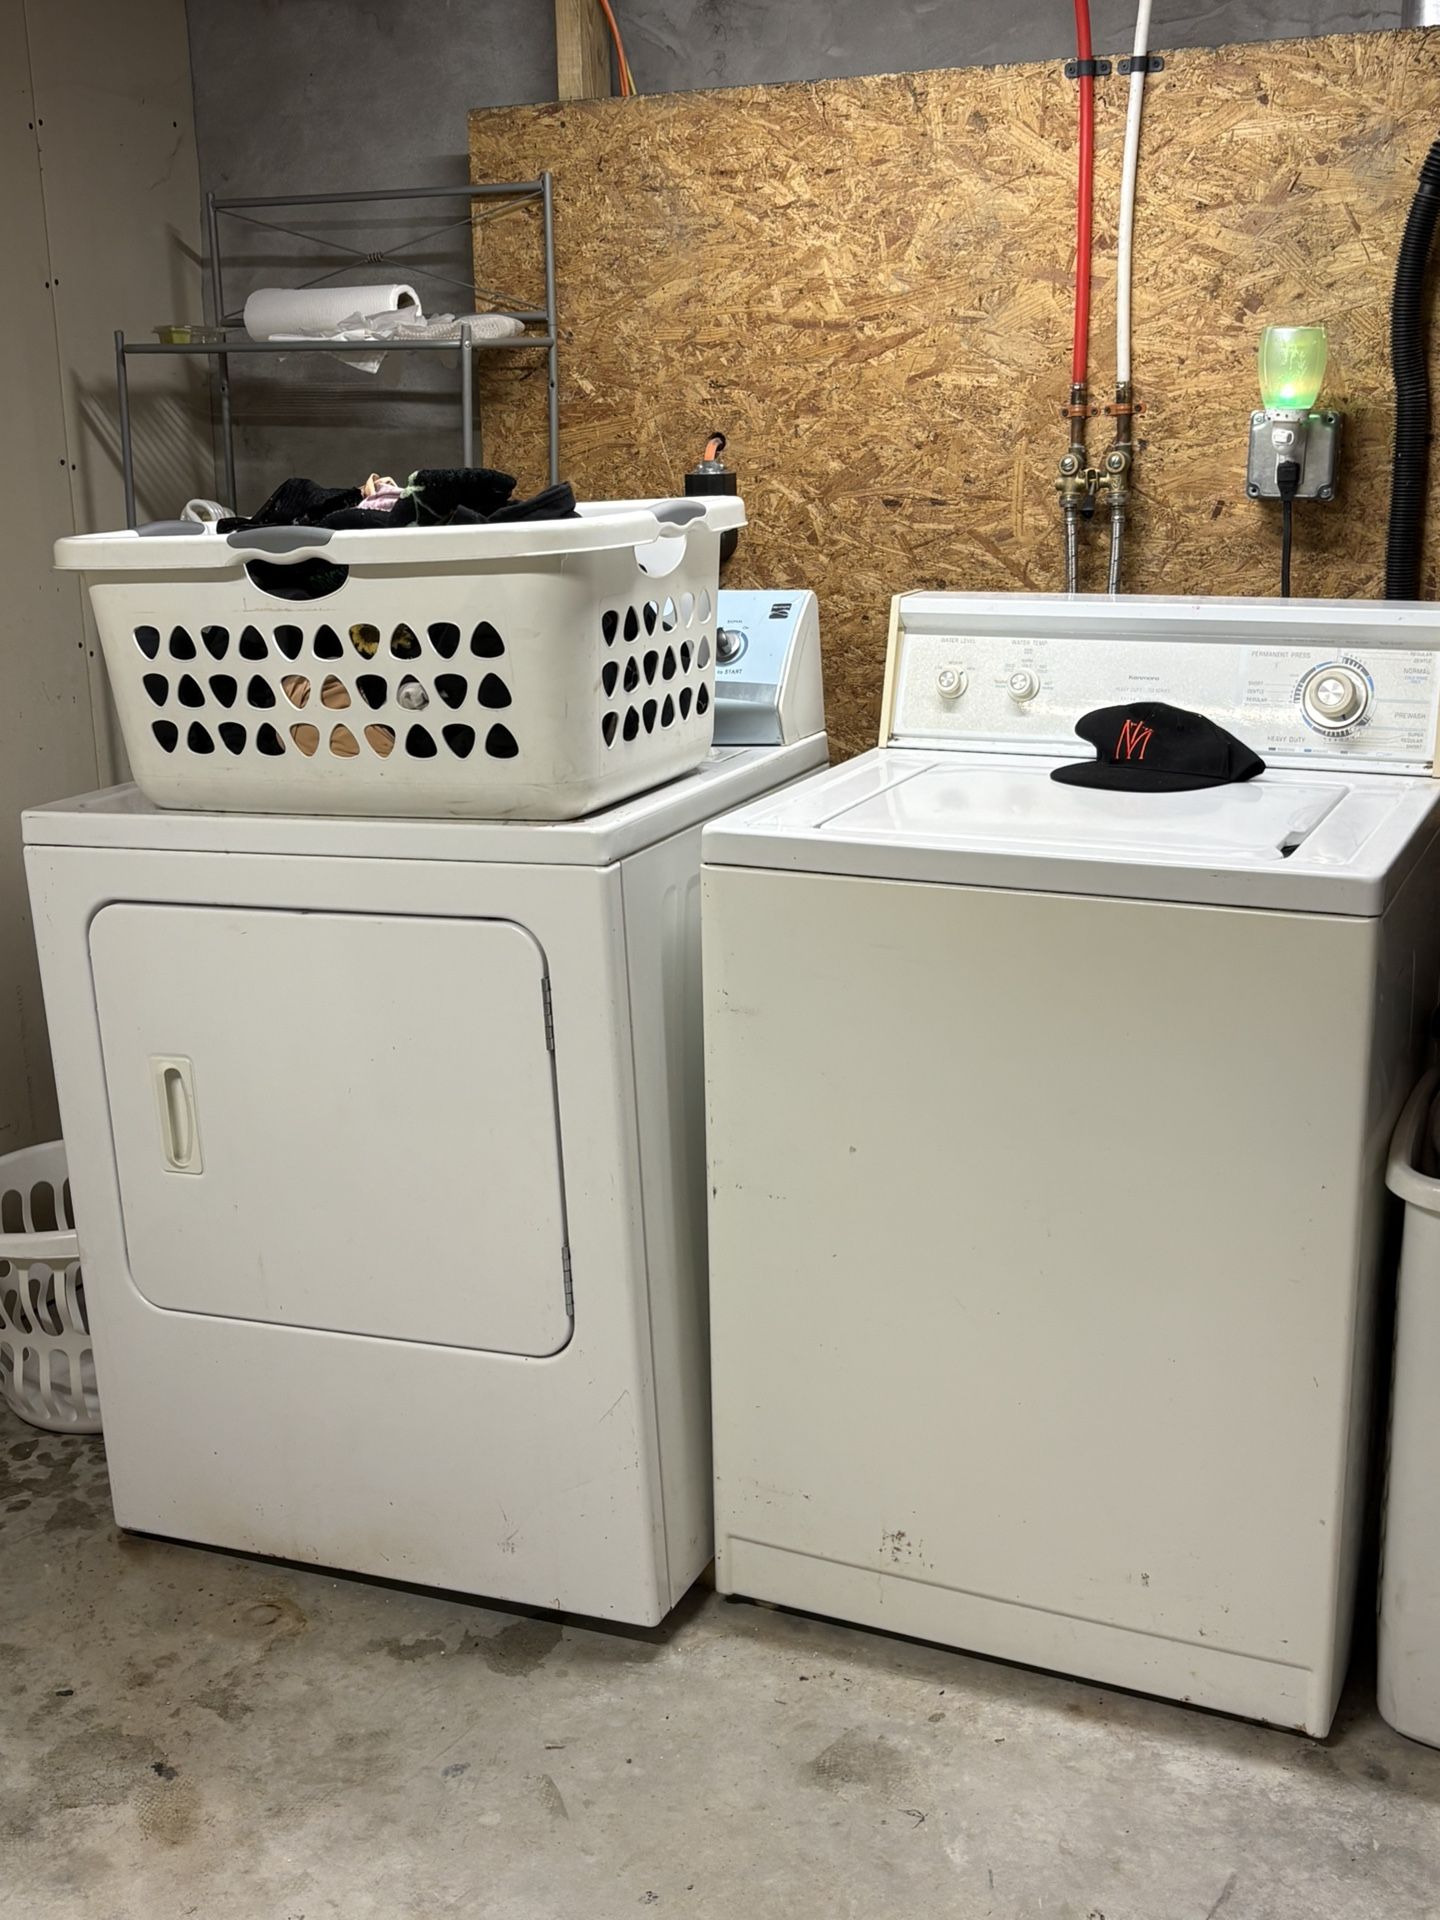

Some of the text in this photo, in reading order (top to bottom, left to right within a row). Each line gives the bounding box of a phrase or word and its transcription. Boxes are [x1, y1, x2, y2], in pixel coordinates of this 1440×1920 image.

[1251, 650, 1311, 659] PERMANENT PRESS
[1403, 667, 1430, 675] NORMAL
[1394, 711, 1426, 719] PREWASH
